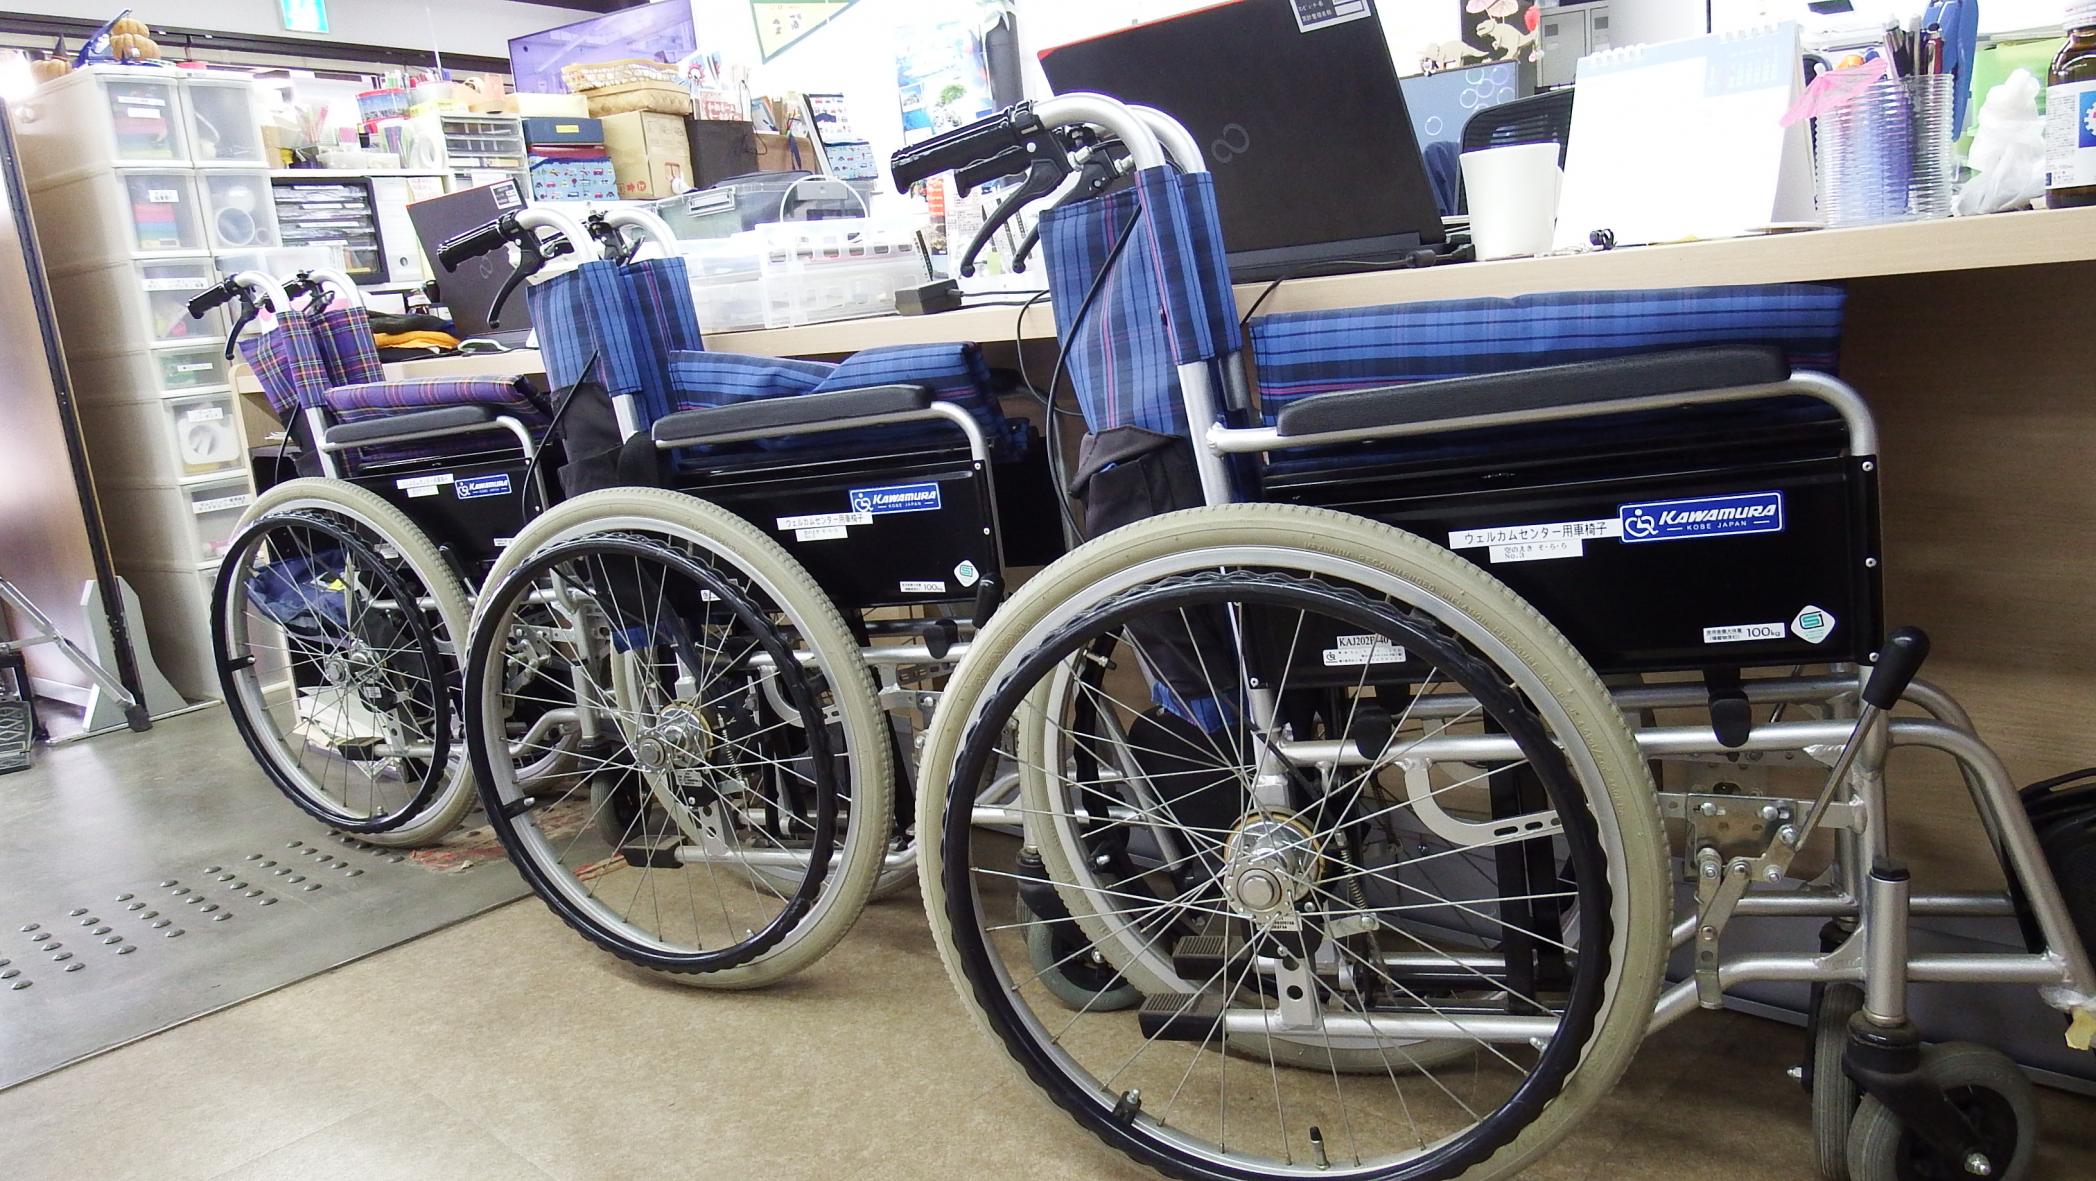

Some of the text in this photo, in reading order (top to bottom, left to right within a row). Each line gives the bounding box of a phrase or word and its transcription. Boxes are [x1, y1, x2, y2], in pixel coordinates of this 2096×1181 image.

[873, 490, 936, 505] KAWAMURA
[1659, 503, 1777, 526] KAWAMURA
[1464, 521, 1608, 543] ウェルカムセンター用車椅子
[1686, 520, 1747, 531] KOBE JAPAN
[1746, 626, 1781, 638] 100kg
